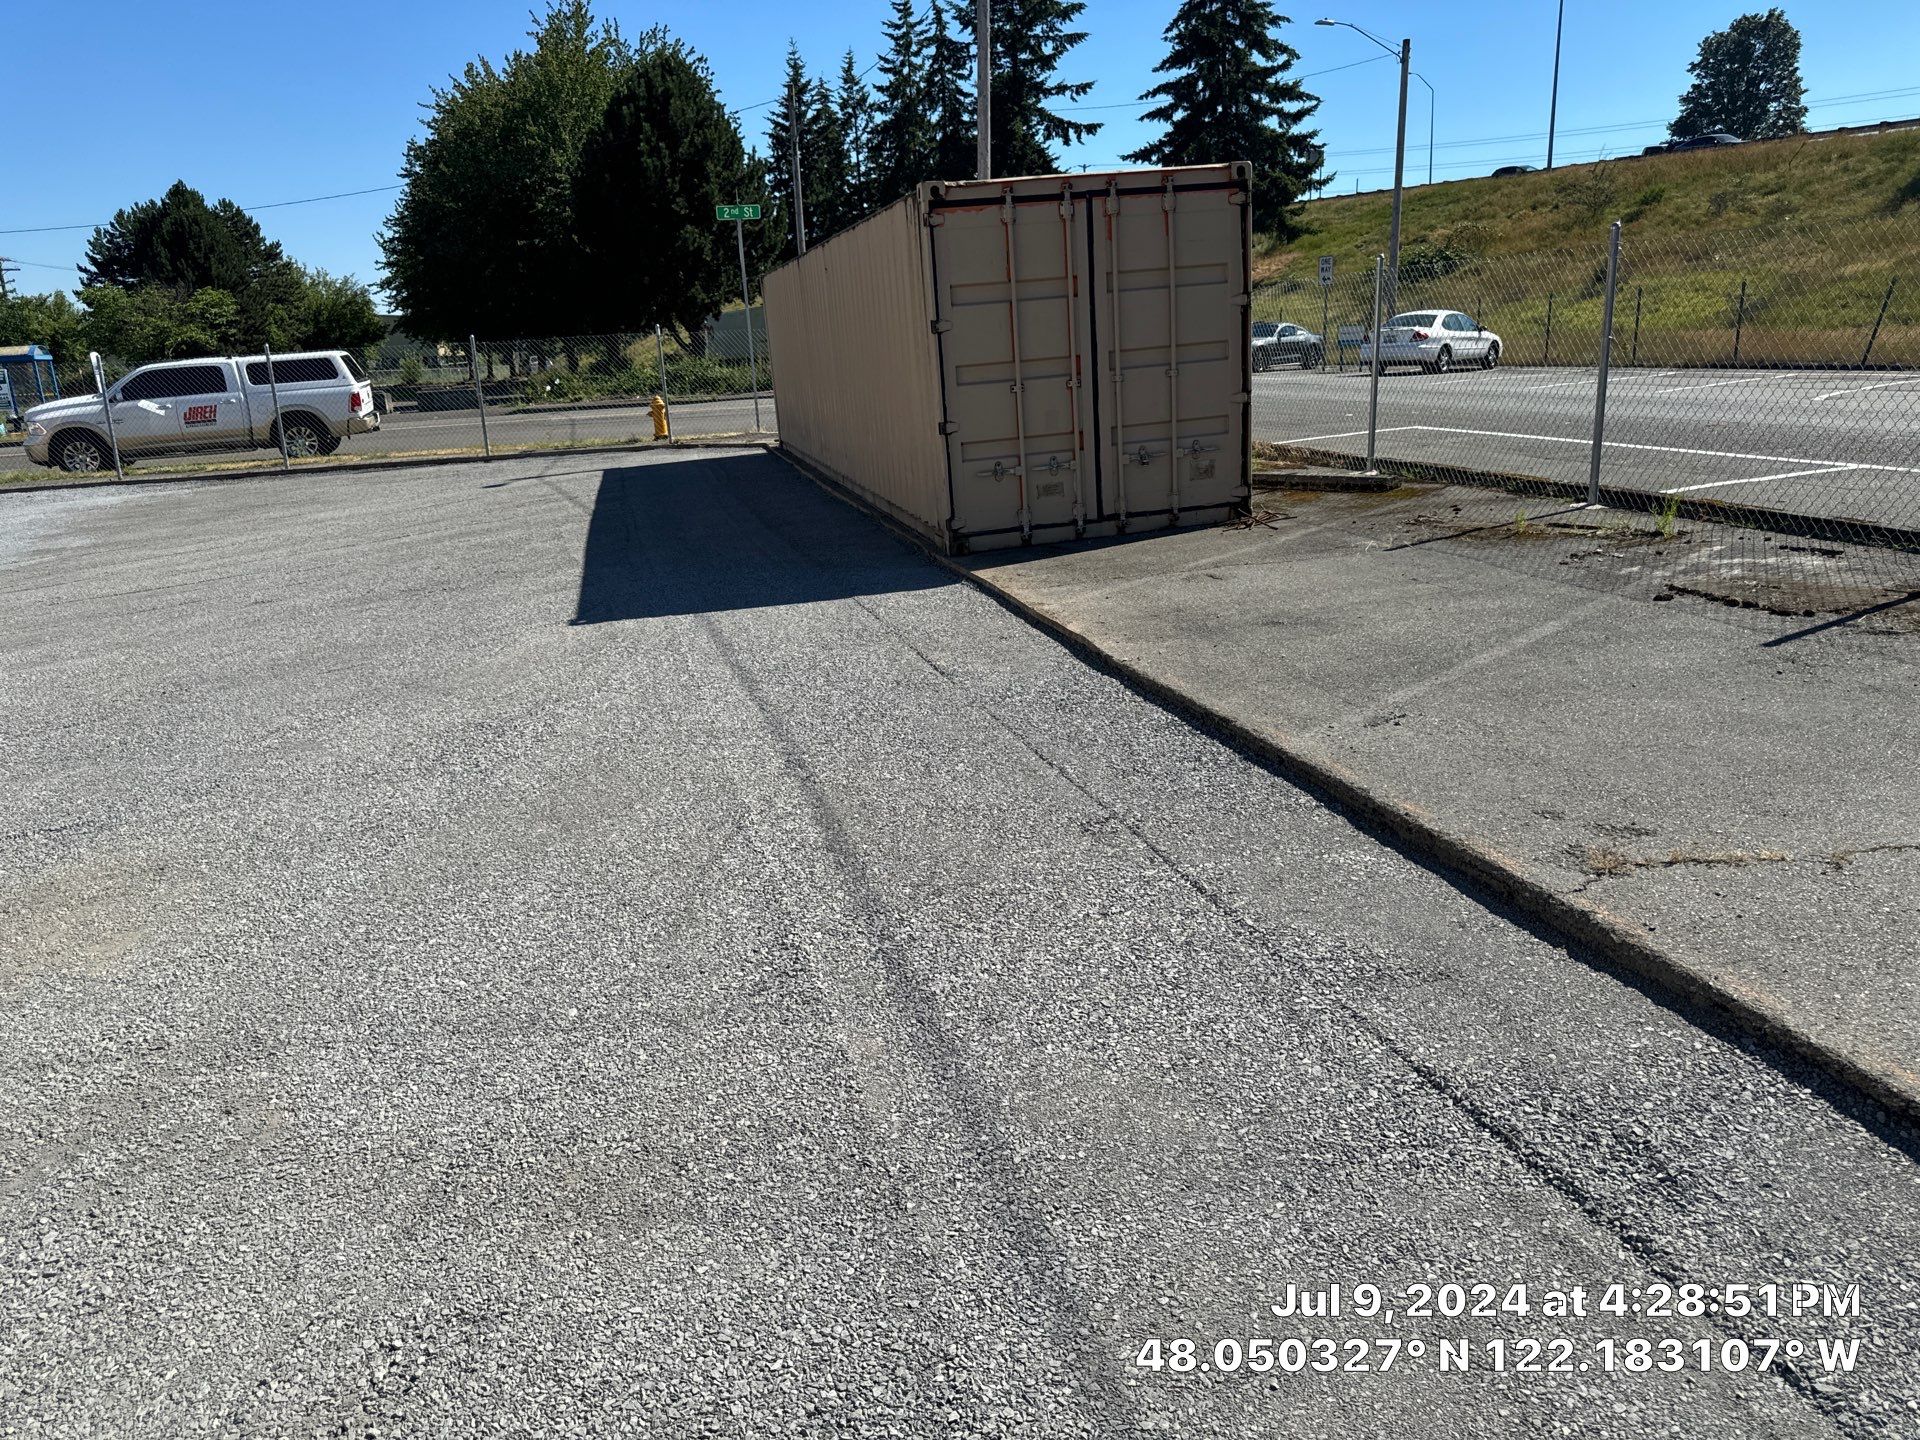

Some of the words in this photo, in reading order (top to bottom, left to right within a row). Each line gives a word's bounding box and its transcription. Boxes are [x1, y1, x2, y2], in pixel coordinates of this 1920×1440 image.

[723, 207, 739, 218] 2nd
[743, 206, 754, 218] St
[1320, 257, 1332, 266] ONE
[1320, 266, 1332, 274] WAY
[183, 404, 218, 422] JIREH
